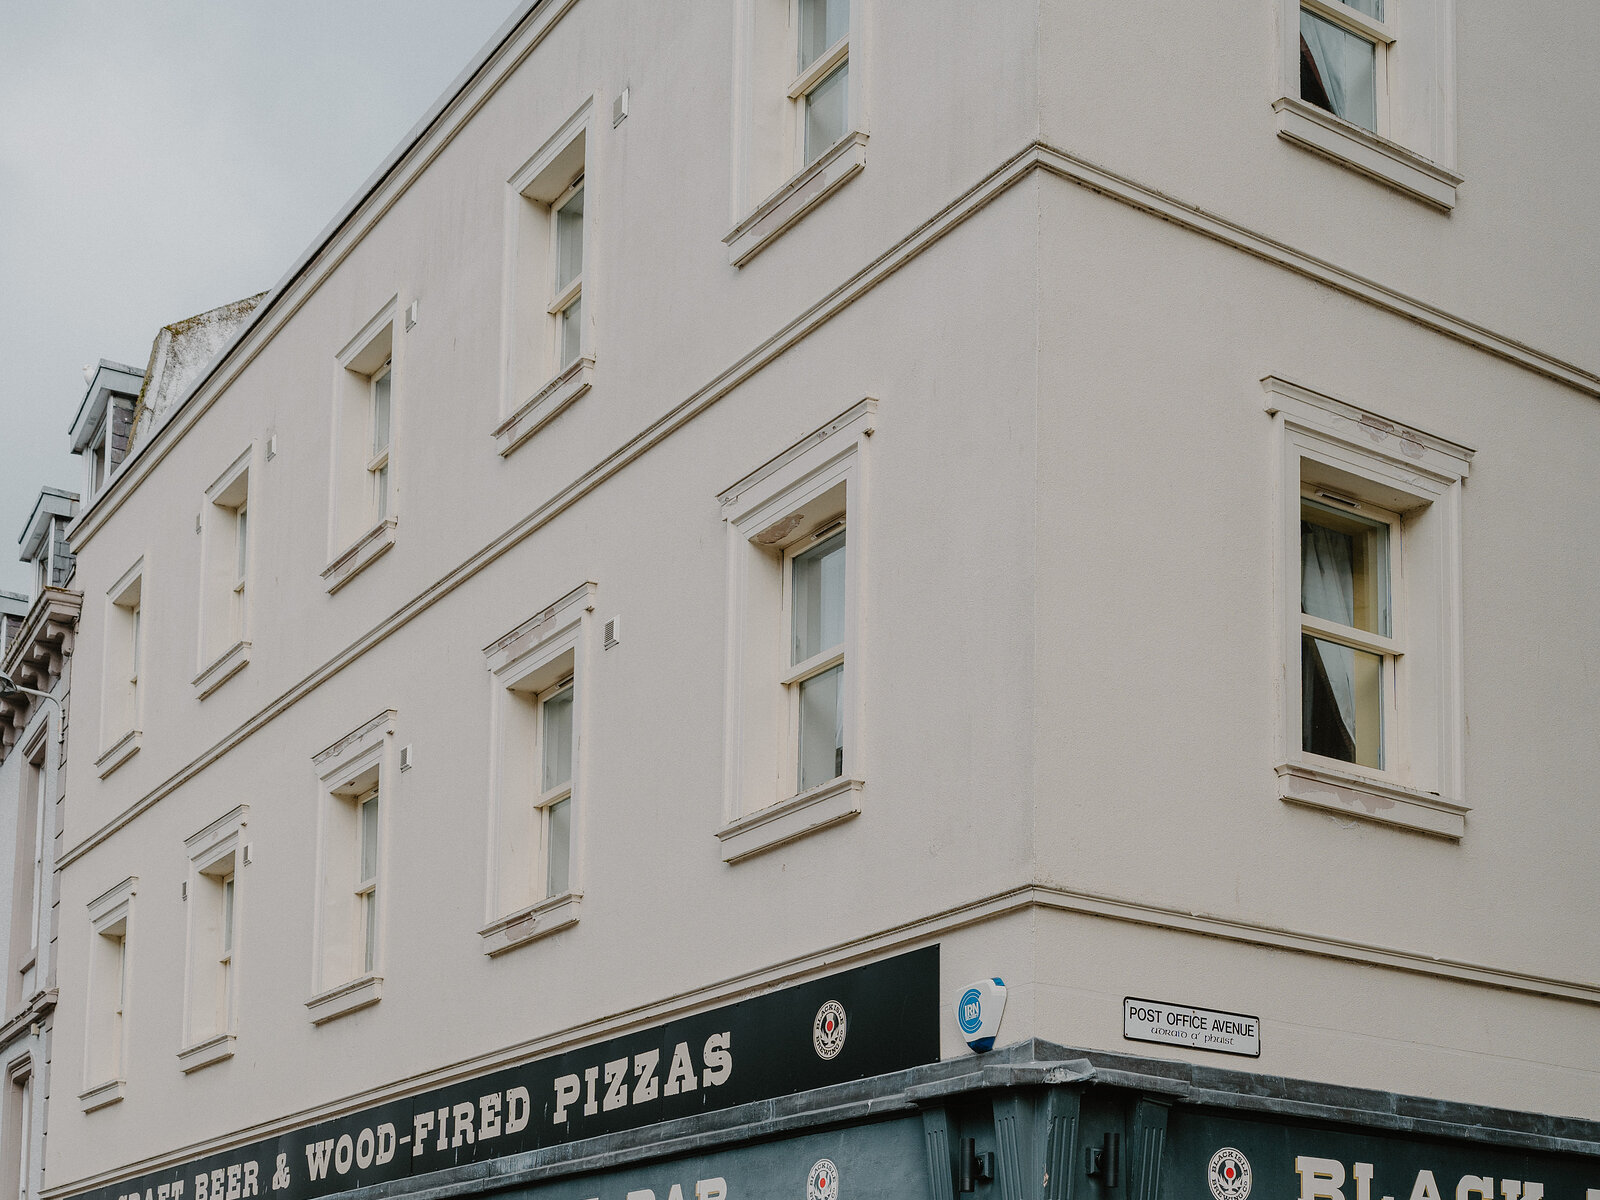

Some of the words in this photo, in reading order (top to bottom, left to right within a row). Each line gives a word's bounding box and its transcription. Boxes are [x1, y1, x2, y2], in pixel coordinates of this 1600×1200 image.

[1129, 1006, 1162, 1023] POST
[1166, 1012, 1208, 1031] OFFICE
[1211, 1019, 1255, 1038] AVENUE
[271, 1152, 291, 1191] &
[305, 1086, 531, 1182] WOOD-FIRED
[553, 1031, 733, 1125] PIZZAS
[1211, 1151, 1234, 1173] BLACK
[1234, 1153, 1249, 1176] ISLE
